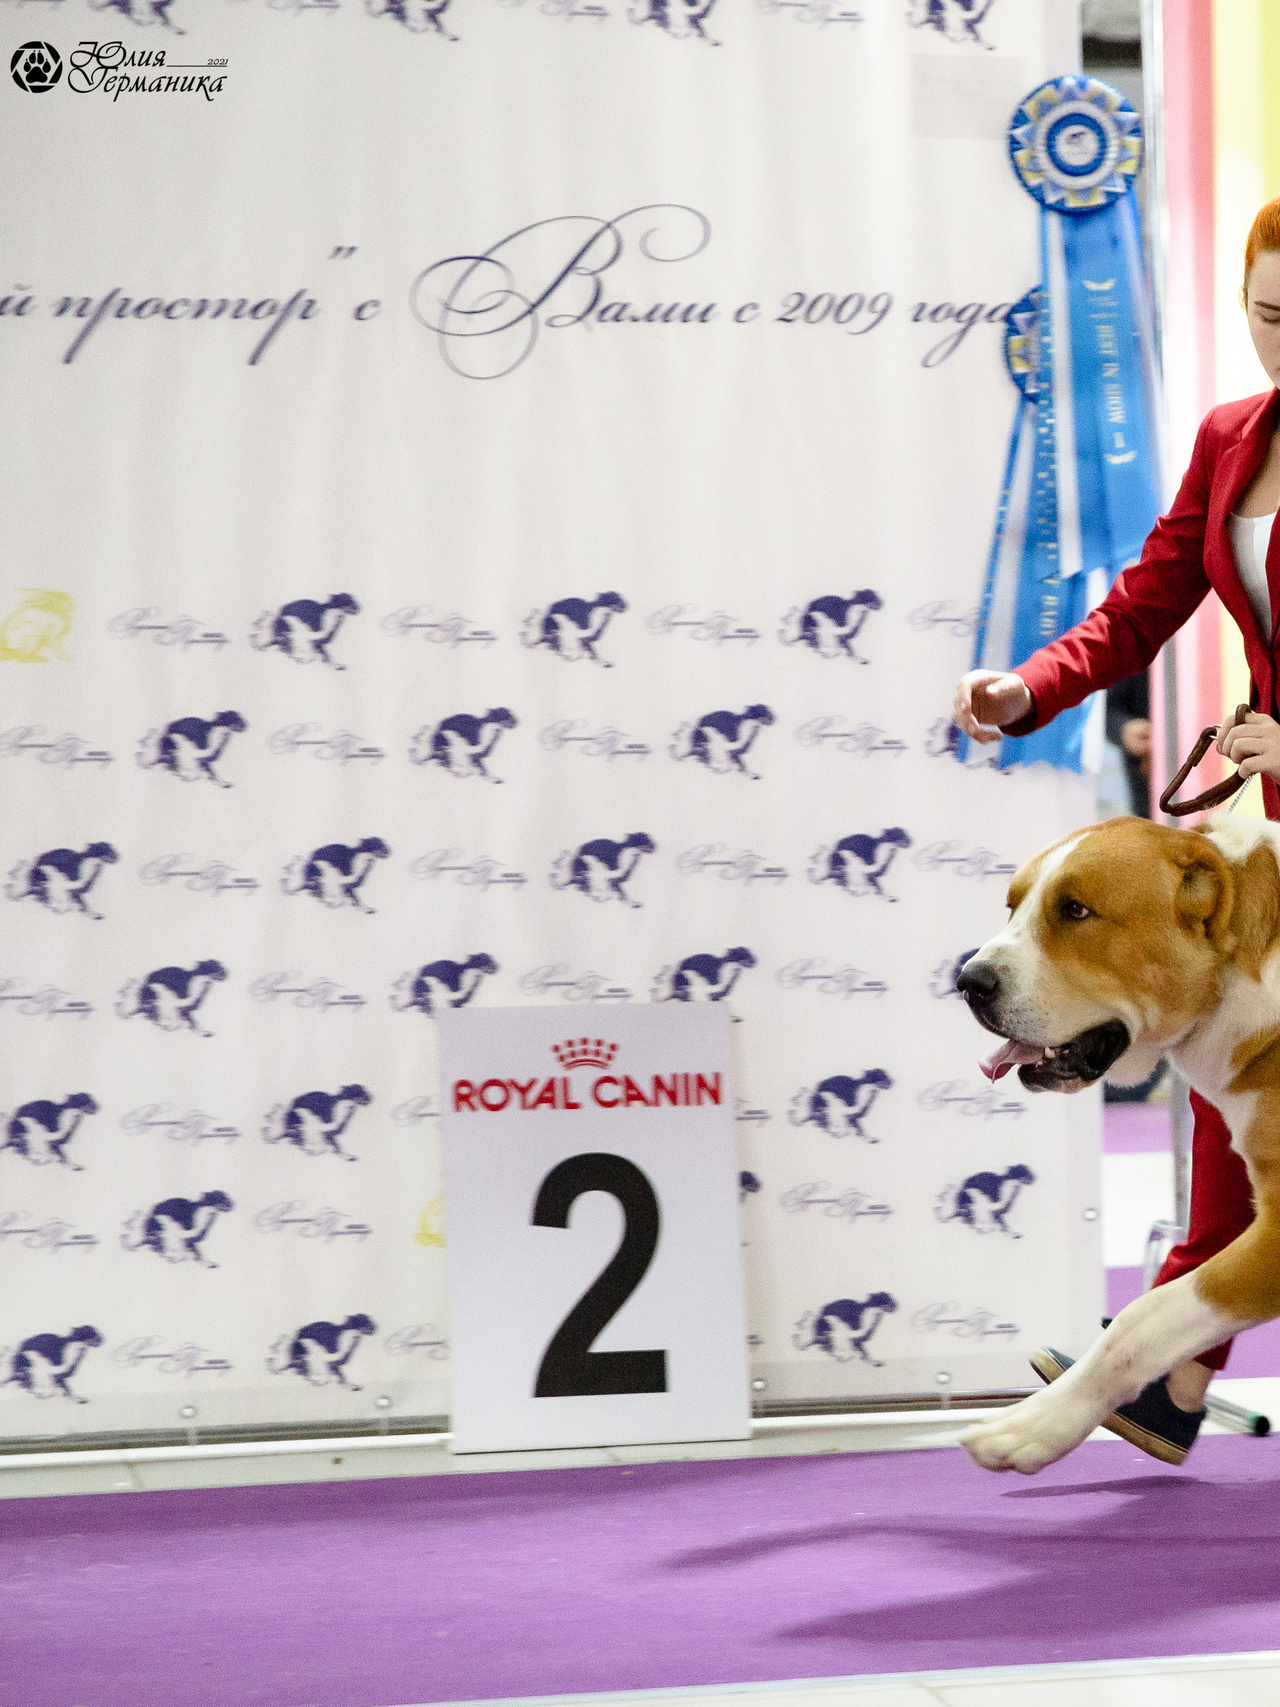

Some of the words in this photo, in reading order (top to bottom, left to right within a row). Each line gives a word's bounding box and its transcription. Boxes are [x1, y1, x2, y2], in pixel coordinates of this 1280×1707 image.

[353, 299, 382, 321] с
[408, 203, 718, 380] Вами
[732, 301, 761, 323] с
[772, 291, 894, 335] 2009
[908, 301, 1011, 368] года
[452, 1077, 581, 1113] ROYAL
[590, 1071, 723, 1109] CANIN
[530, 1151, 669, 1399] 2
